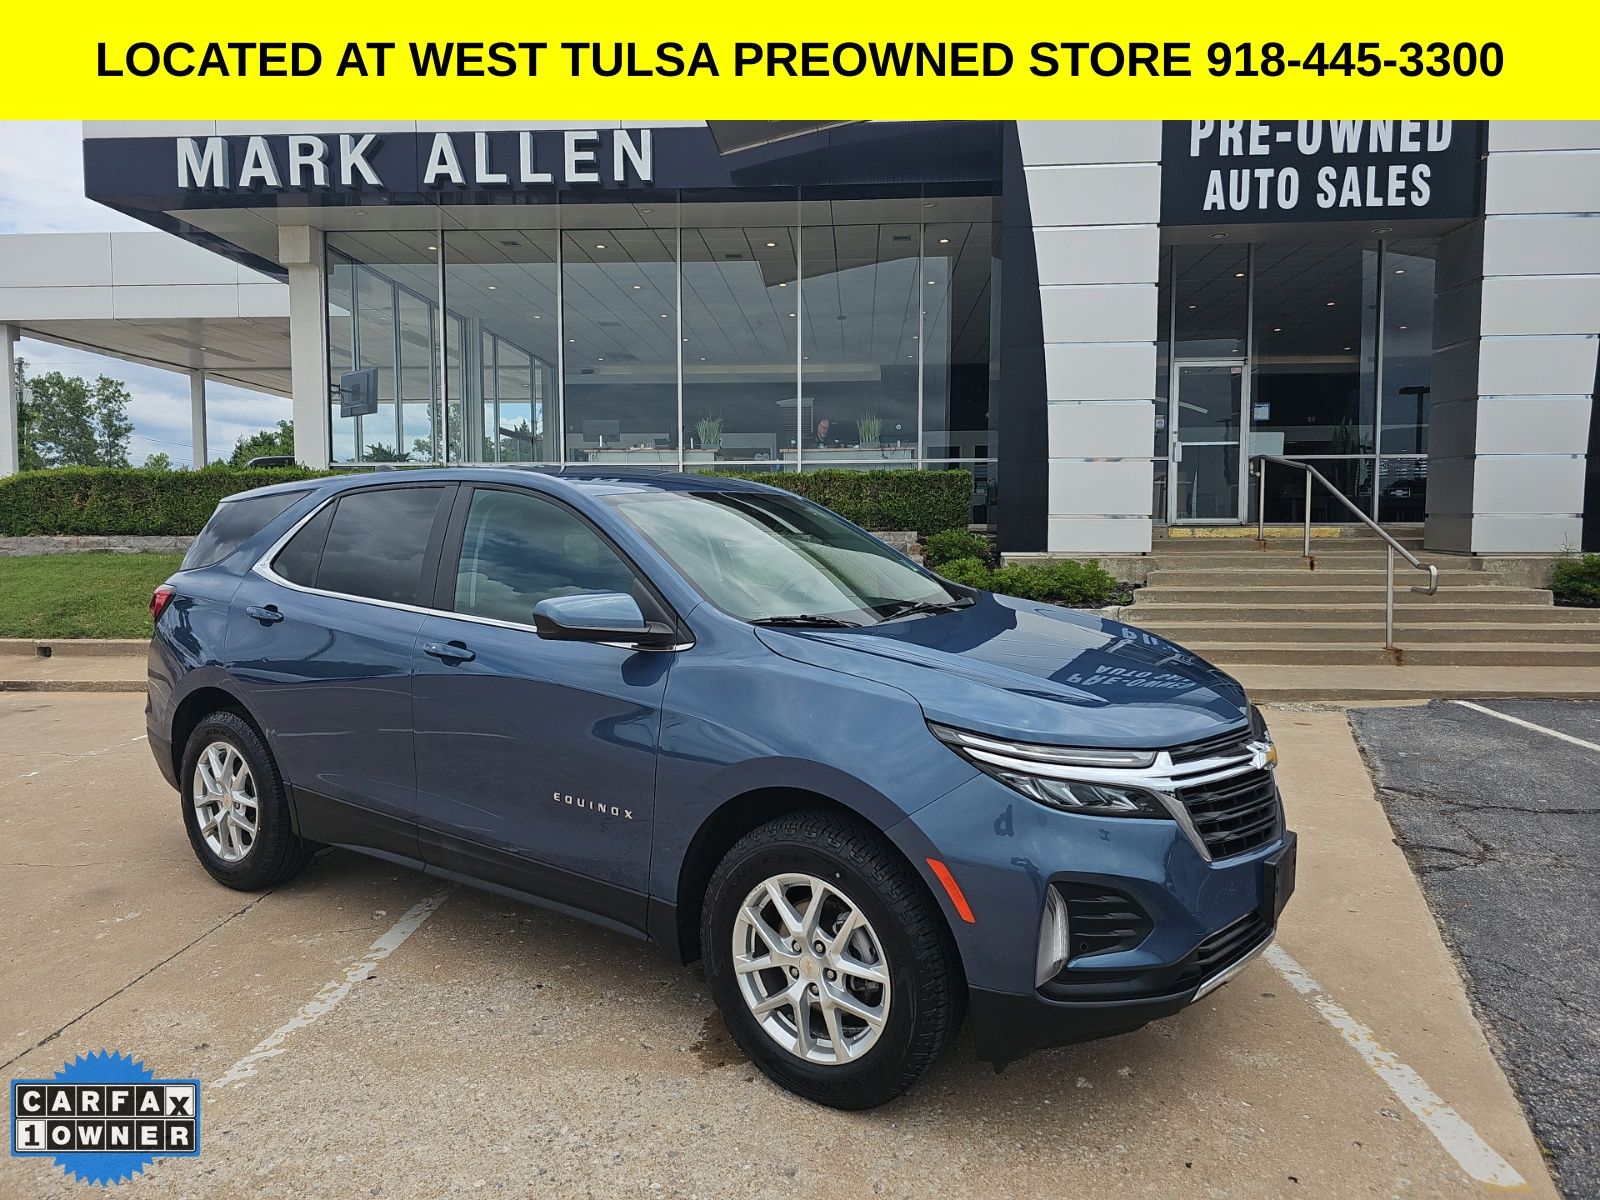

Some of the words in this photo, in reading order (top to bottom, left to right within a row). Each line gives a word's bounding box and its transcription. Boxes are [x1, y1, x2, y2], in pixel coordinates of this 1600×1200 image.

[176, 133, 383, 189] MARK
[423, 129, 655, 186] ALLEN
[1190, 120, 1453, 157] PRE-OWNED
[1203, 167, 1300, 211] AUTO
[1316, 163, 1432, 209] SALES
[553, 792, 633, 820] EQUINOX
